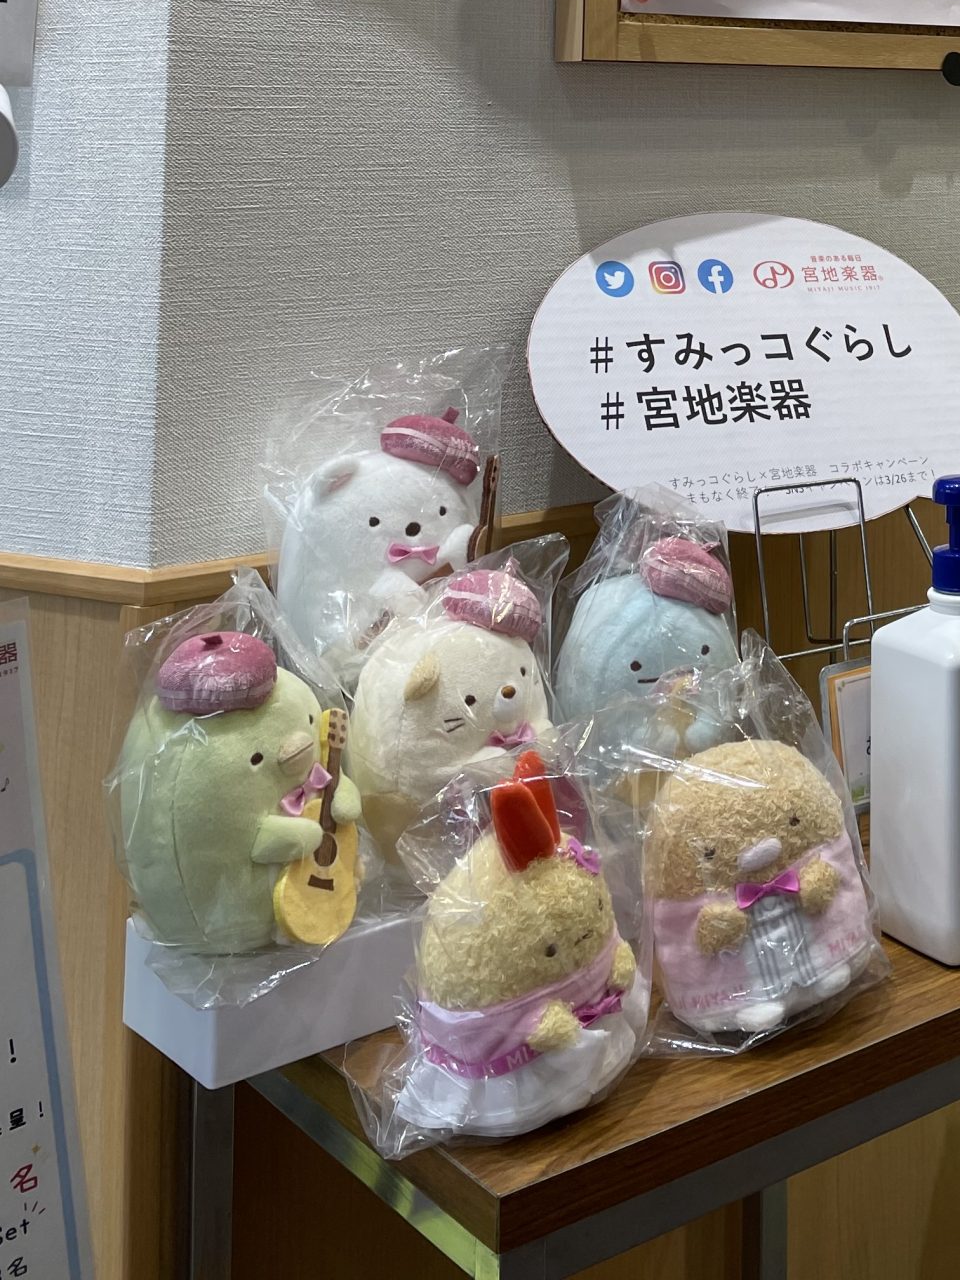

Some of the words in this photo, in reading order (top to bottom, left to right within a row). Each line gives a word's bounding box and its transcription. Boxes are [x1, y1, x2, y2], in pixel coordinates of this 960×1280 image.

[838, 285, 863, 293] MUSIC
[829, 455, 928, 474] コラボキャンペーン
[10, 1163, 38, 1193] 名
